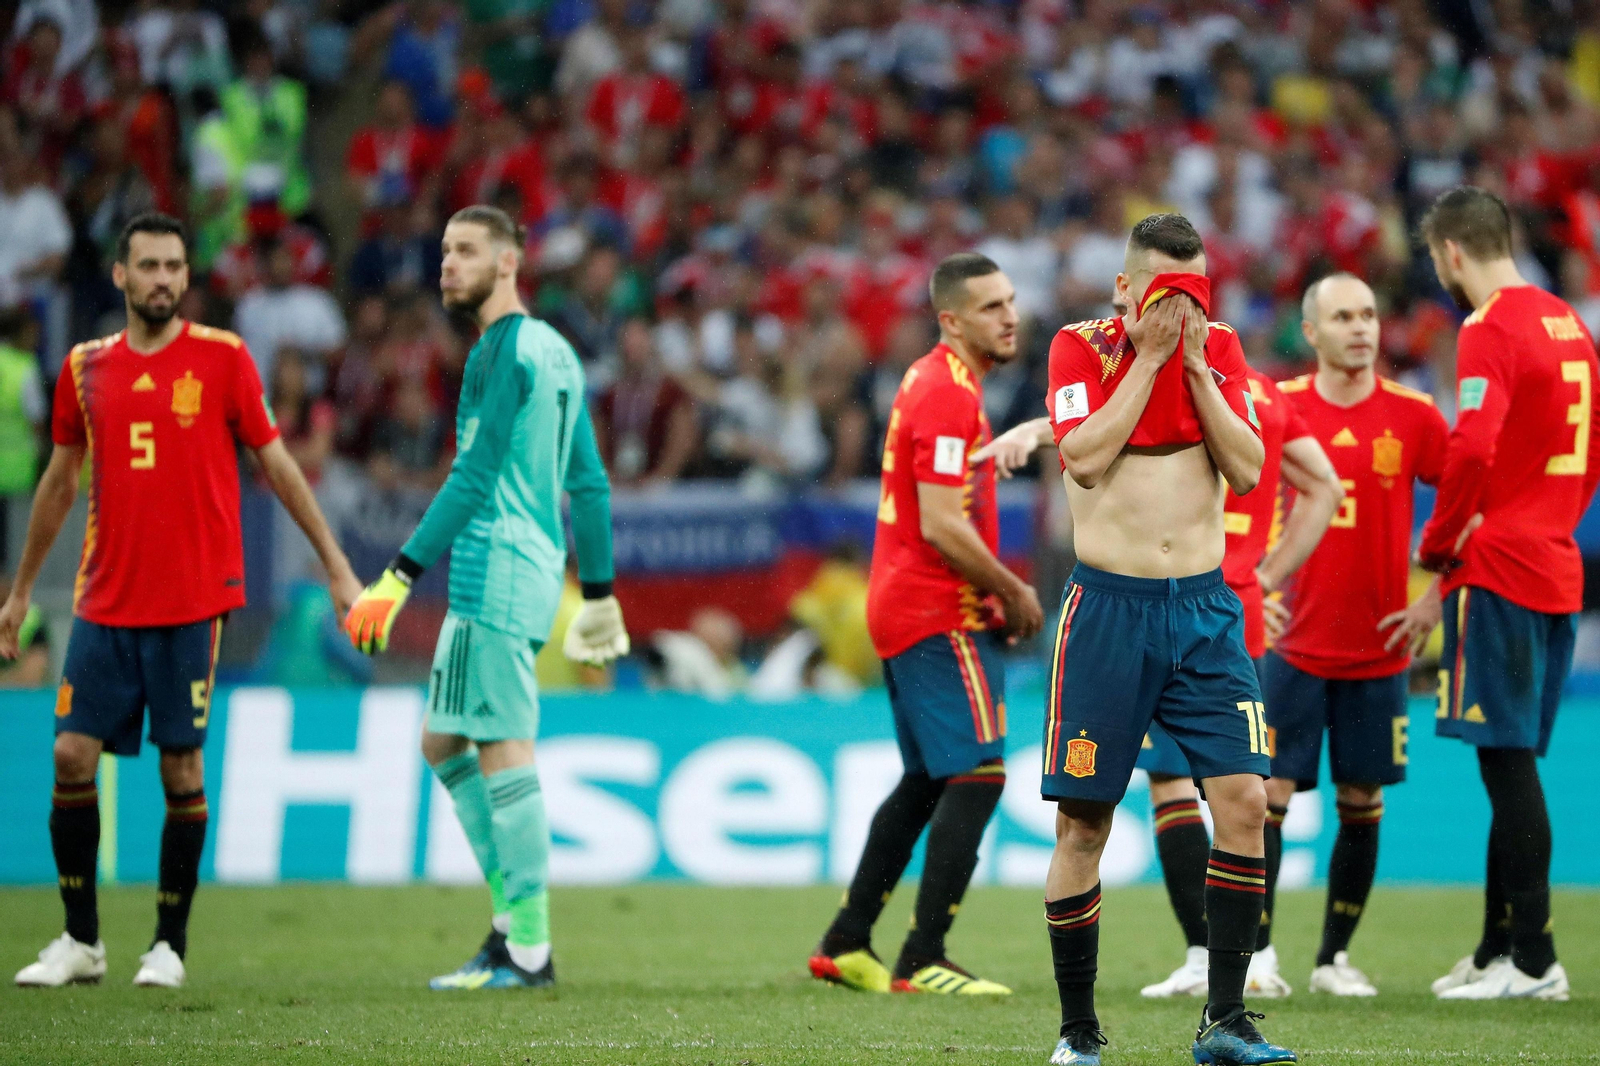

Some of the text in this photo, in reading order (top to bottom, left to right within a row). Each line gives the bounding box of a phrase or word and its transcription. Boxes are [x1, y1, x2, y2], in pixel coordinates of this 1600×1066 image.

[130, 422, 155, 469] 5
[556, 389, 568, 466] 1
[1544, 361, 1590, 475] 3
[191, 680, 208, 729] 5
